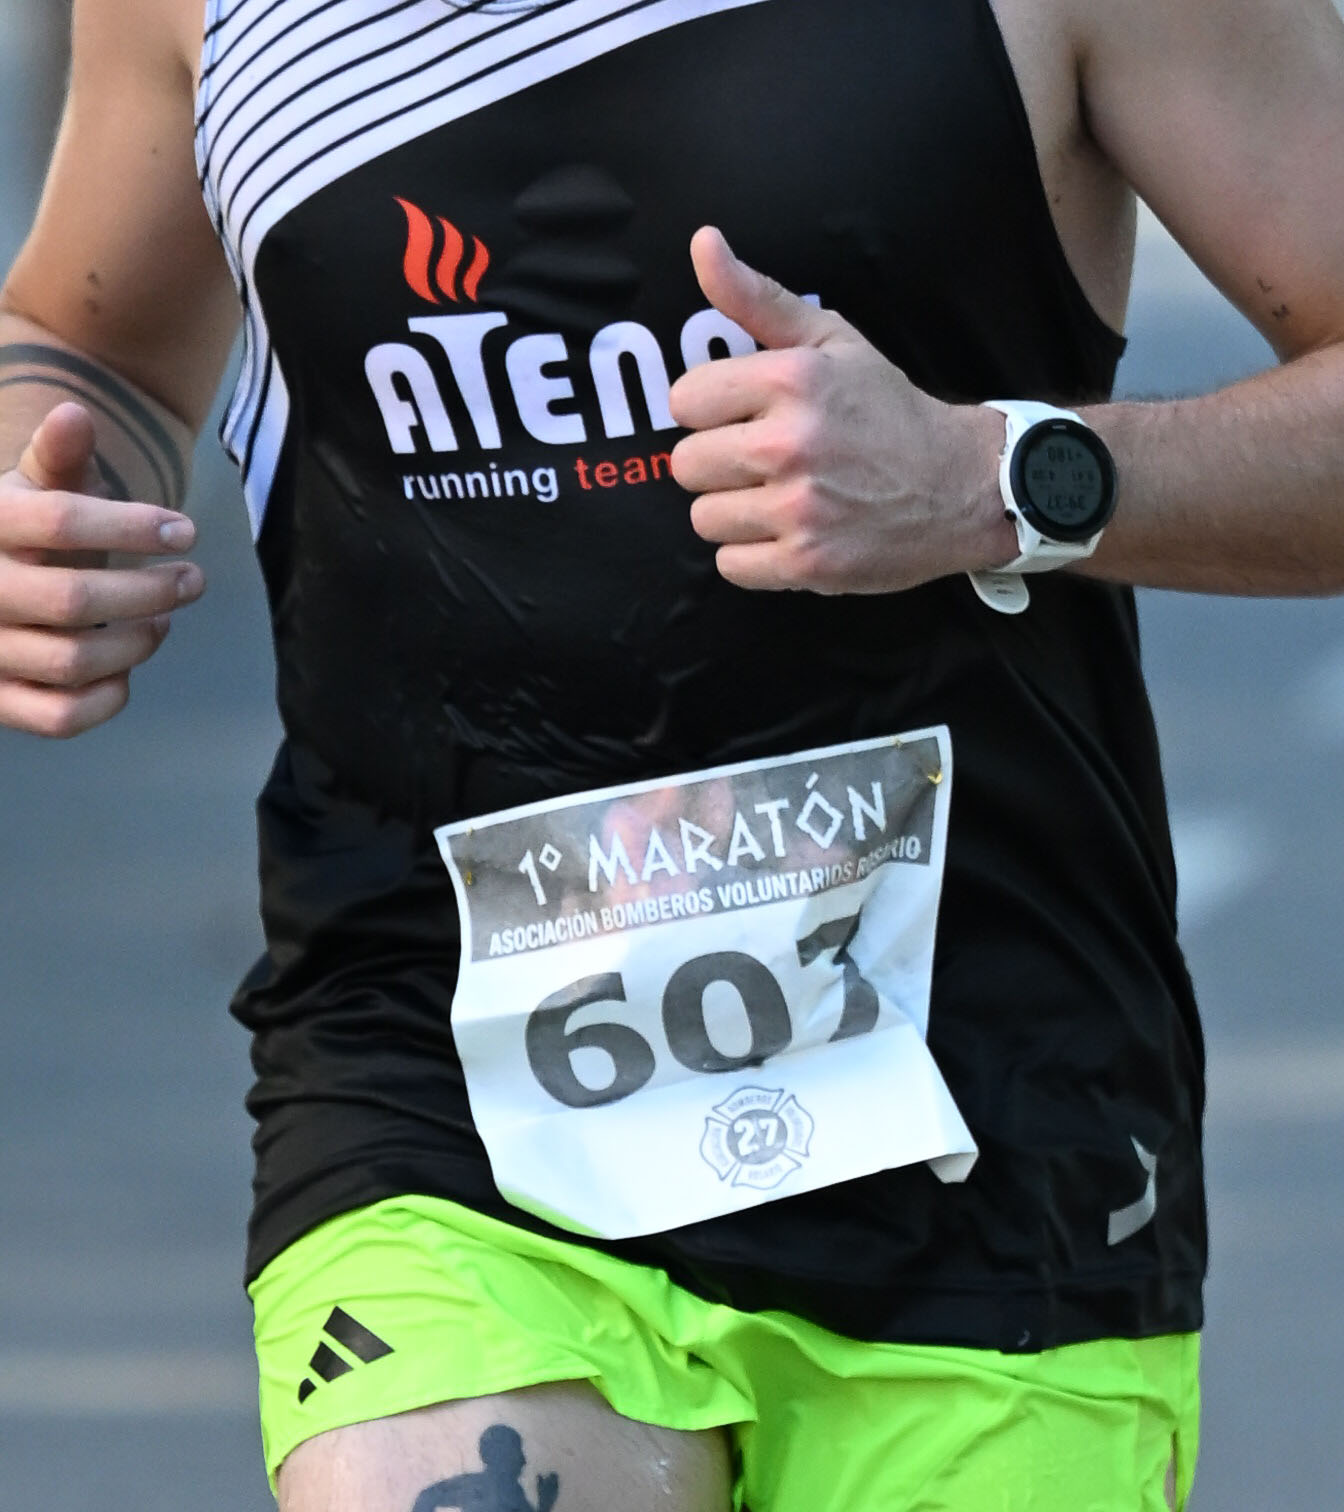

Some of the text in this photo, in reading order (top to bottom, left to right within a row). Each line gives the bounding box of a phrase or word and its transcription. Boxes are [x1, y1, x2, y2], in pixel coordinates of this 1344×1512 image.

[403, 461, 559, 503] running
[587, 772, 889, 893] MARATÓN
[488, 908, 599, 957] ASOCIACIÓN
[599, 887, 716, 932] BOMBEROS
[716, 860, 853, 909] VOLUNTARIOS
[733, 1117, 779, 1157] 27
